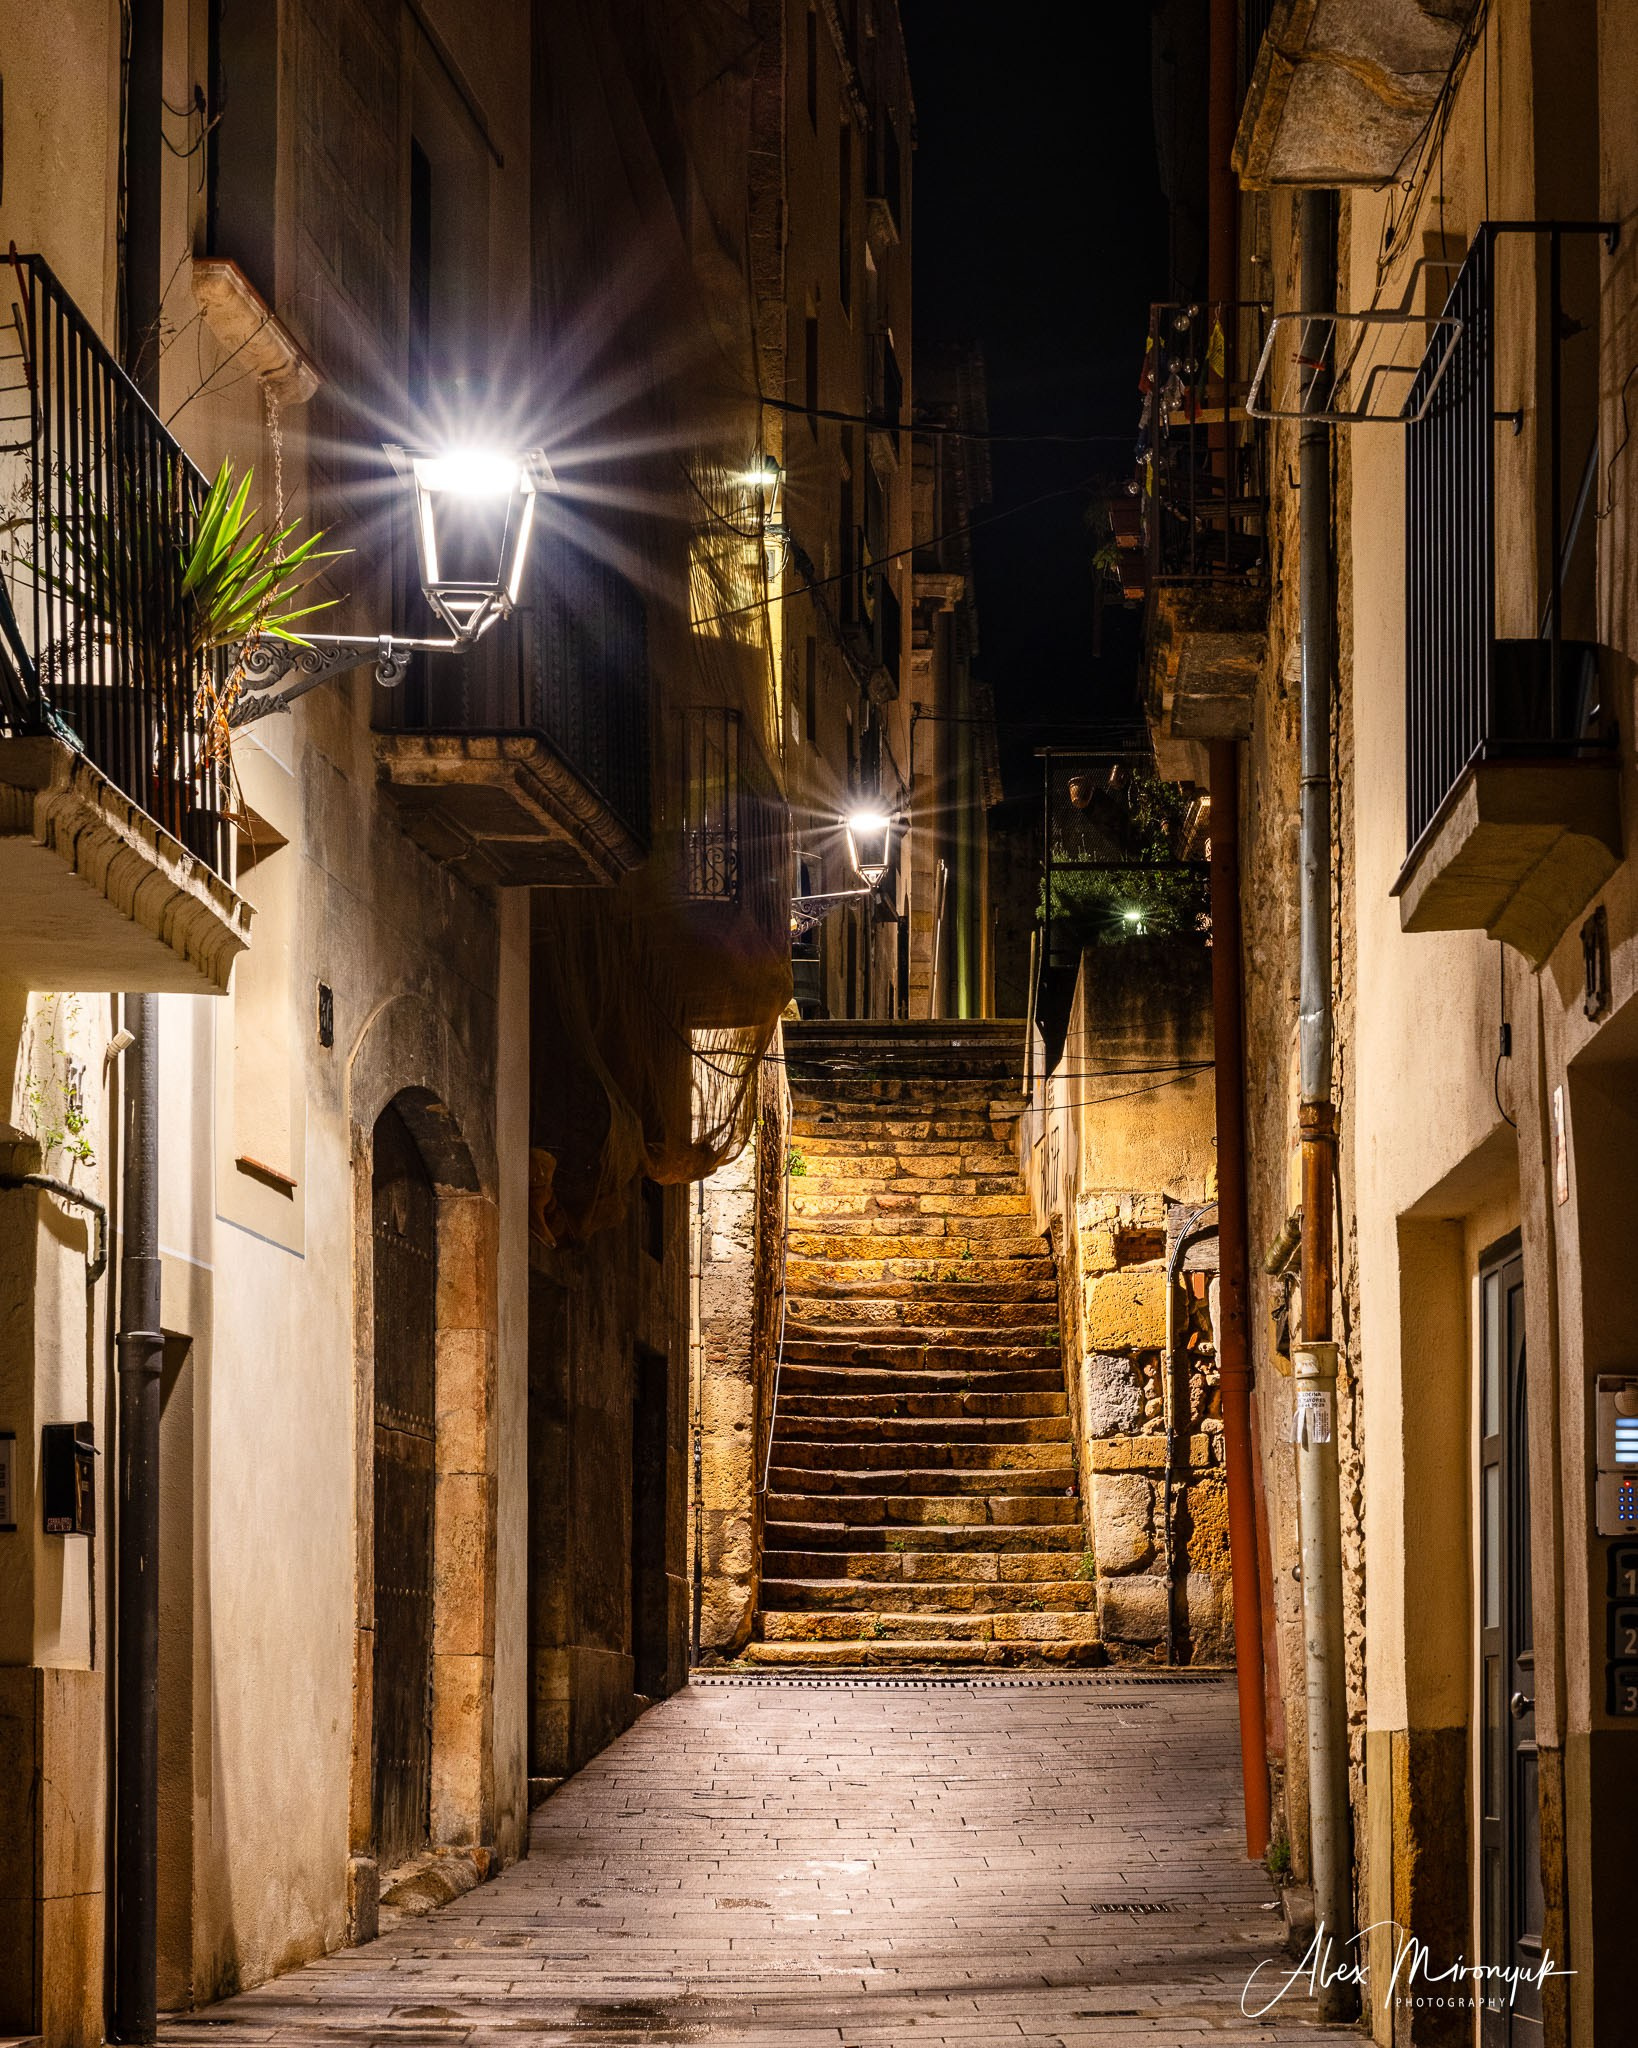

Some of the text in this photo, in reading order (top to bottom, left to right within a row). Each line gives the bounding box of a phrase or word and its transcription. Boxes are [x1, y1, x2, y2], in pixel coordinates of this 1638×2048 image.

[1624, 1569, 1637, 1595] 1
[1624, 1628, 1637, 1655] 2
[1624, 1686, 1638, 1712] 3
